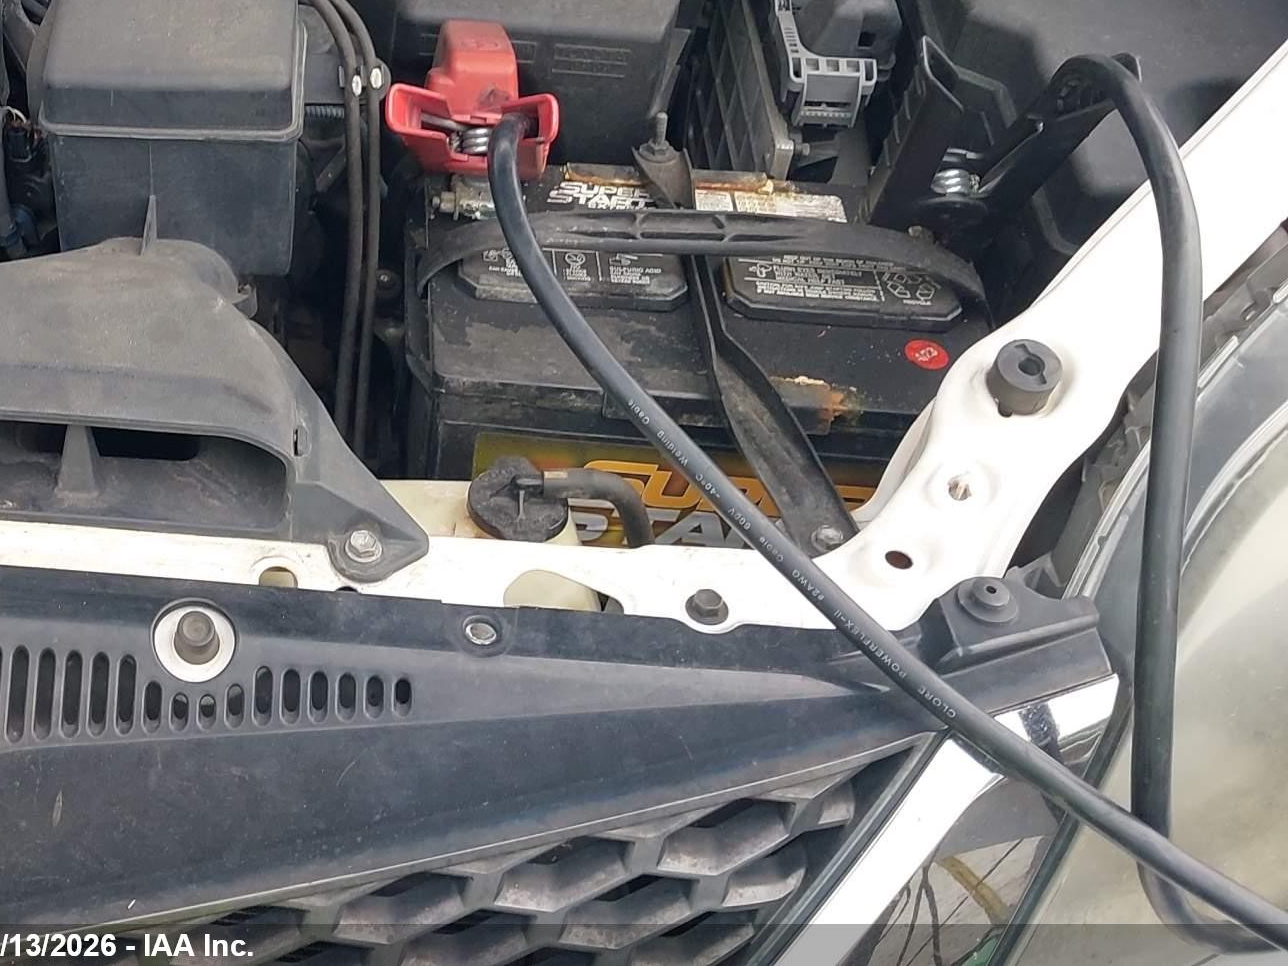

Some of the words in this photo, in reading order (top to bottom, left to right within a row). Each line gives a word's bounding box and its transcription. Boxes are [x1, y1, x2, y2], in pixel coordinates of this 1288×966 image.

[546, 190, 654, 209] START
[559, 181, 650, 198] SUPER
[627, 397, 650, 425] Cable
[656, 429, 689, 467] Welding
[917, 684, 957, 718] CLORE
